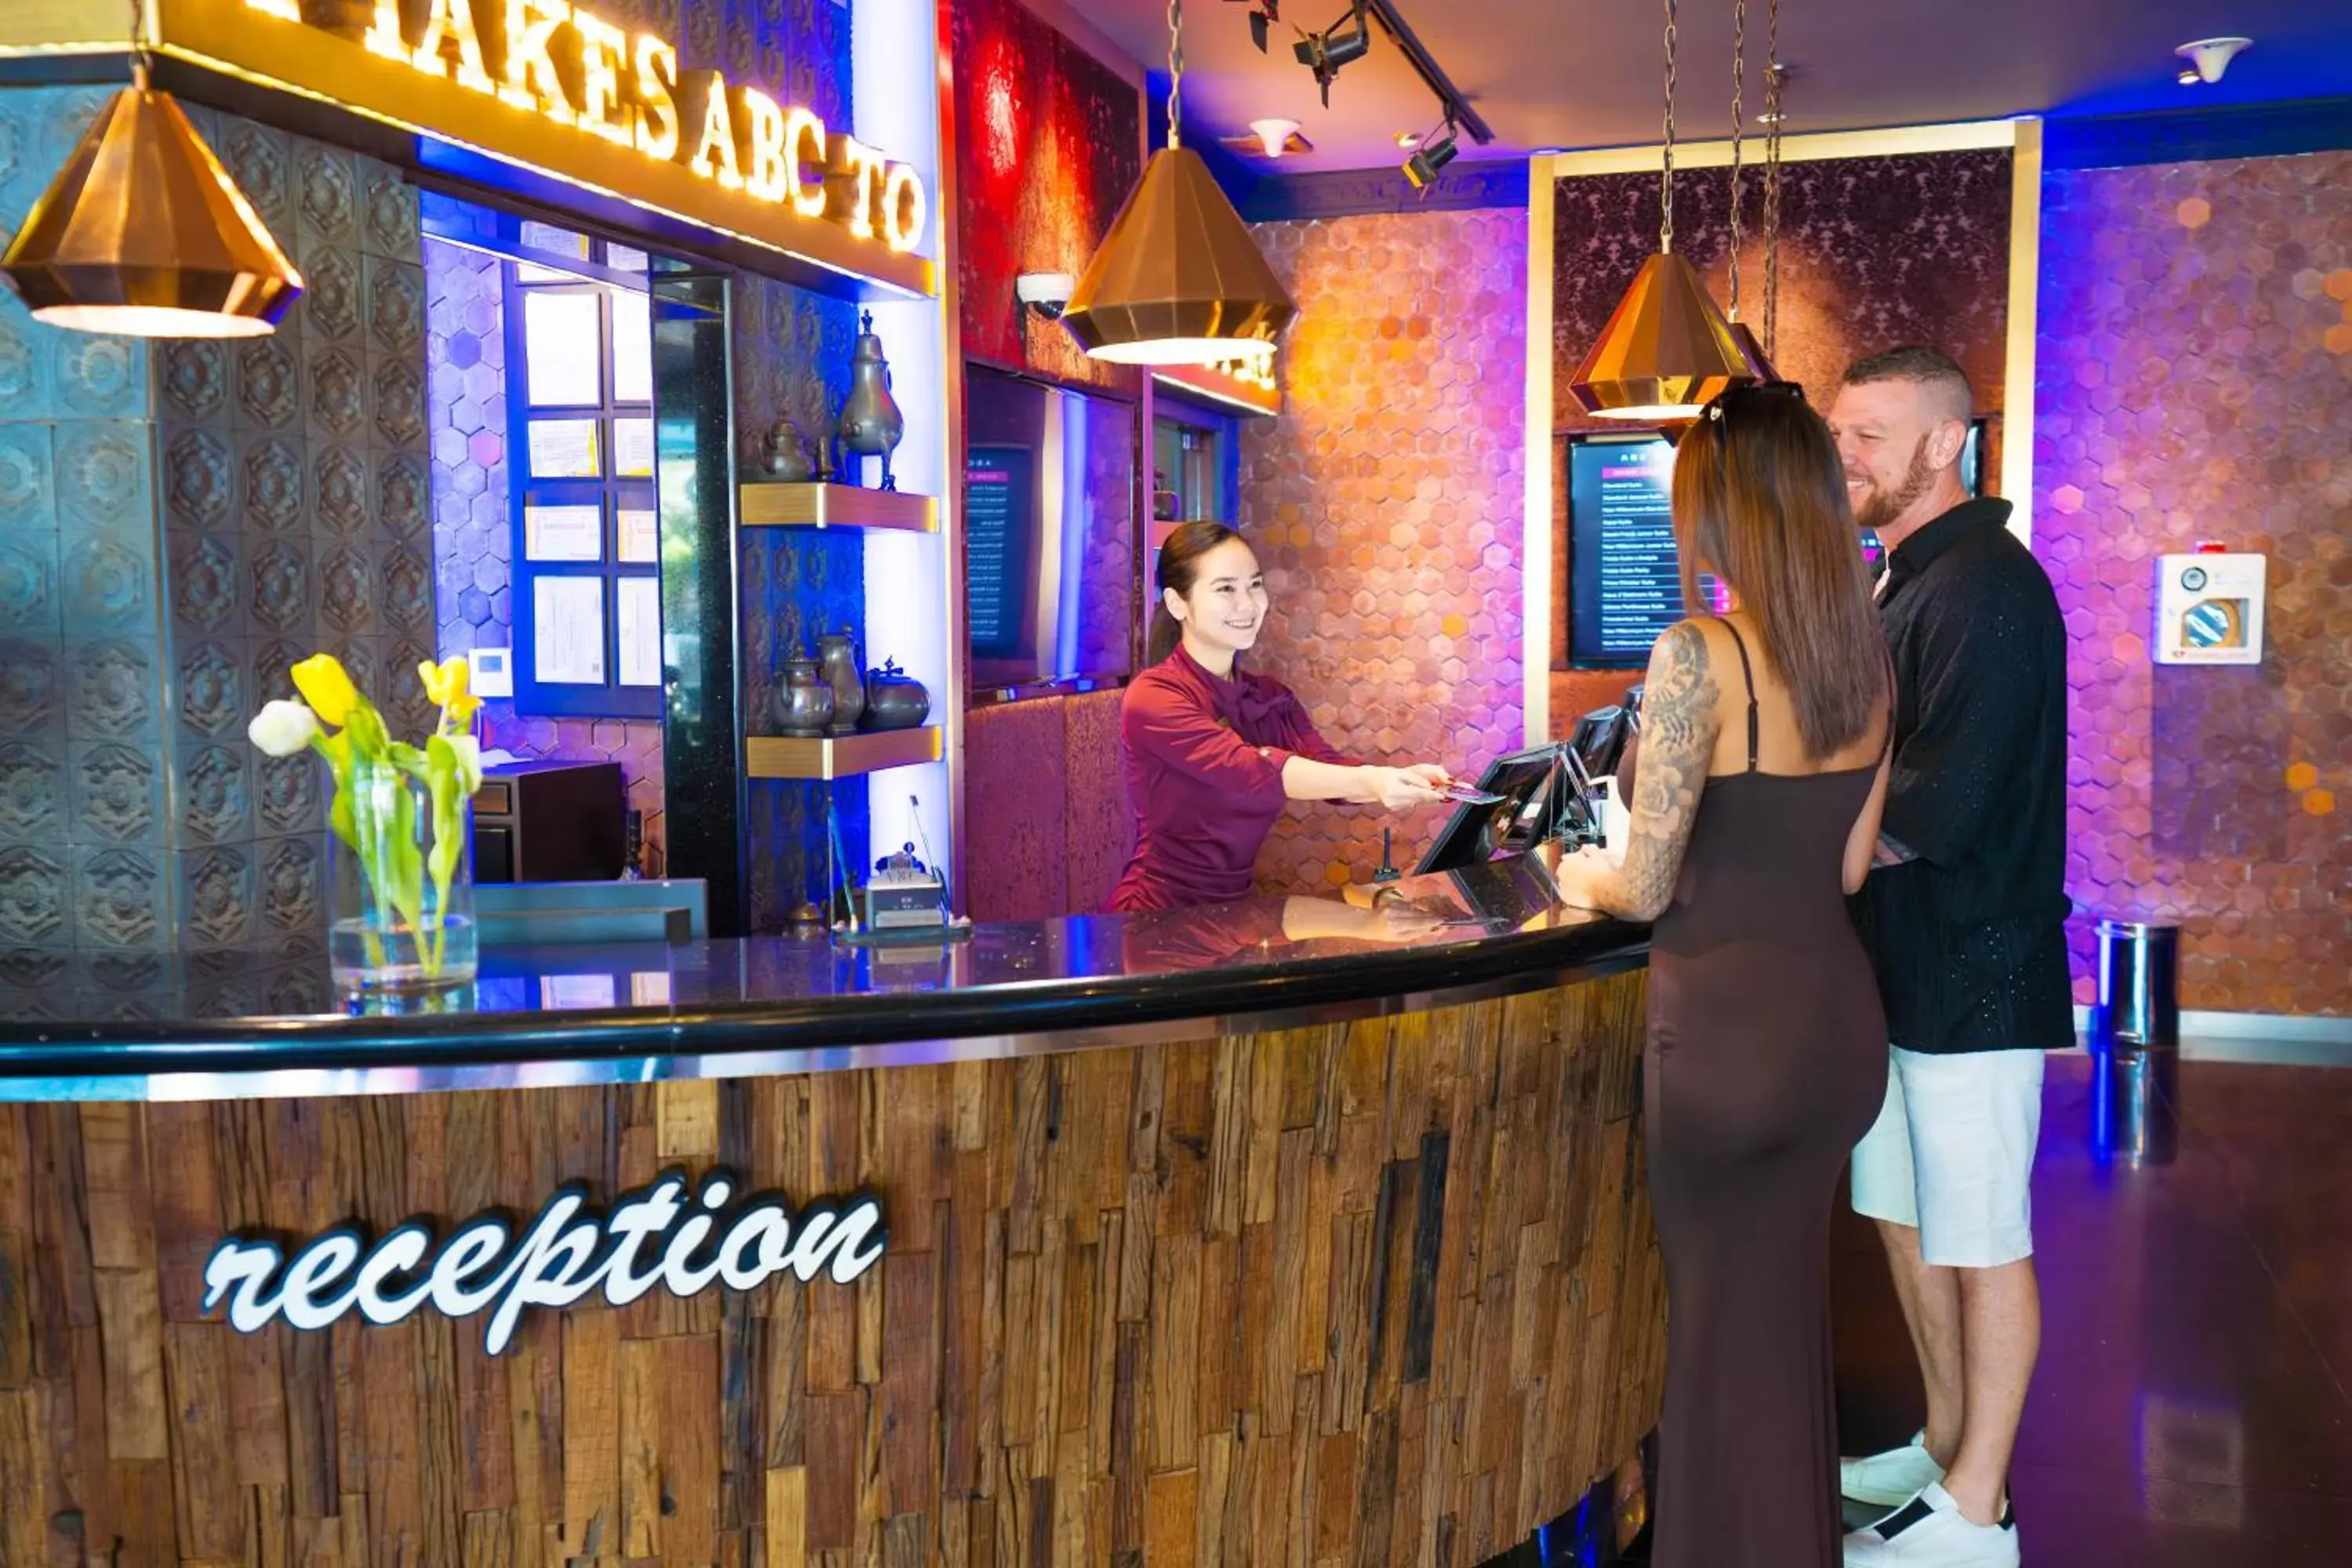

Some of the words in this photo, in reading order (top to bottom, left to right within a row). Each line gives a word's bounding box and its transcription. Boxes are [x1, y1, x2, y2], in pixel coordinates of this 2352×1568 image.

[691, 70, 826, 218] ABC
[845, 134, 926, 252] TO
[202, 1176, 886, 1356] reception
